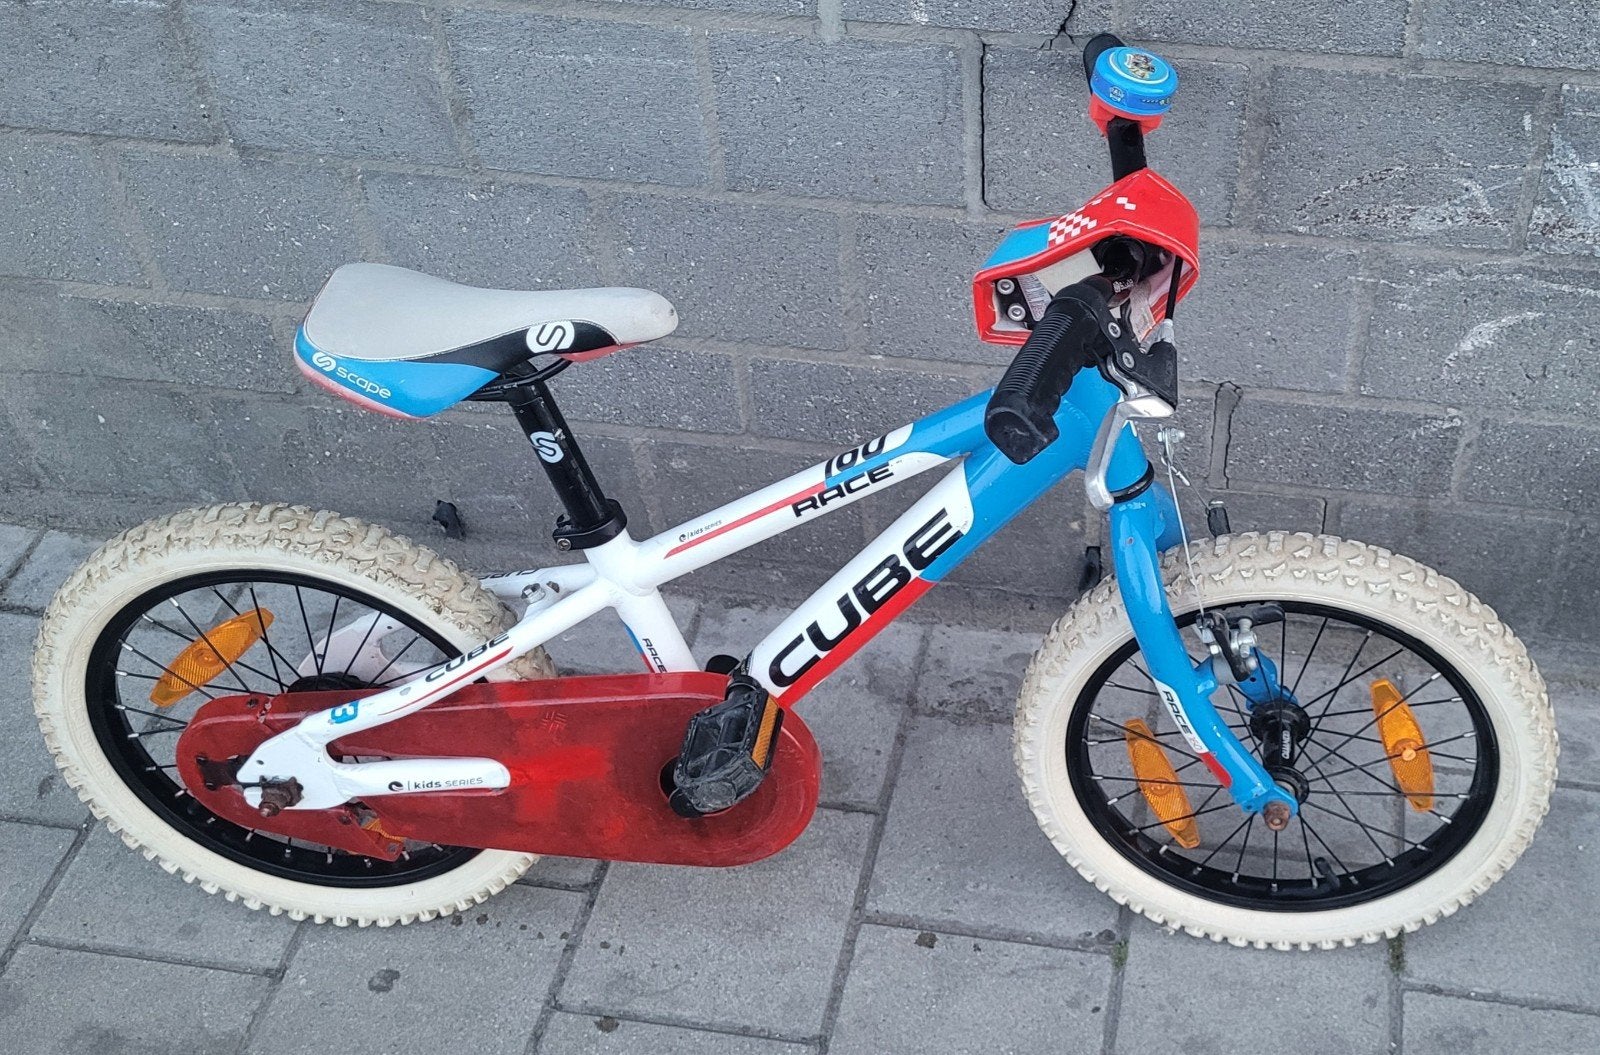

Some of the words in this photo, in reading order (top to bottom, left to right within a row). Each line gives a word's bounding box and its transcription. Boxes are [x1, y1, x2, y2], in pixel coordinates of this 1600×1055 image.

[336, 366, 391, 399] scape
[791, 461, 894, 517] RACE
[769, 507, 965, 688] CUBE
[424, 633, 510, 683] CUBE
[642, 637, 667, 674] RACE
[1162, 691, 1193, 735] RACE
[414, 781, 441, 789] kids
[444, 777, 484, 787] SERIES
